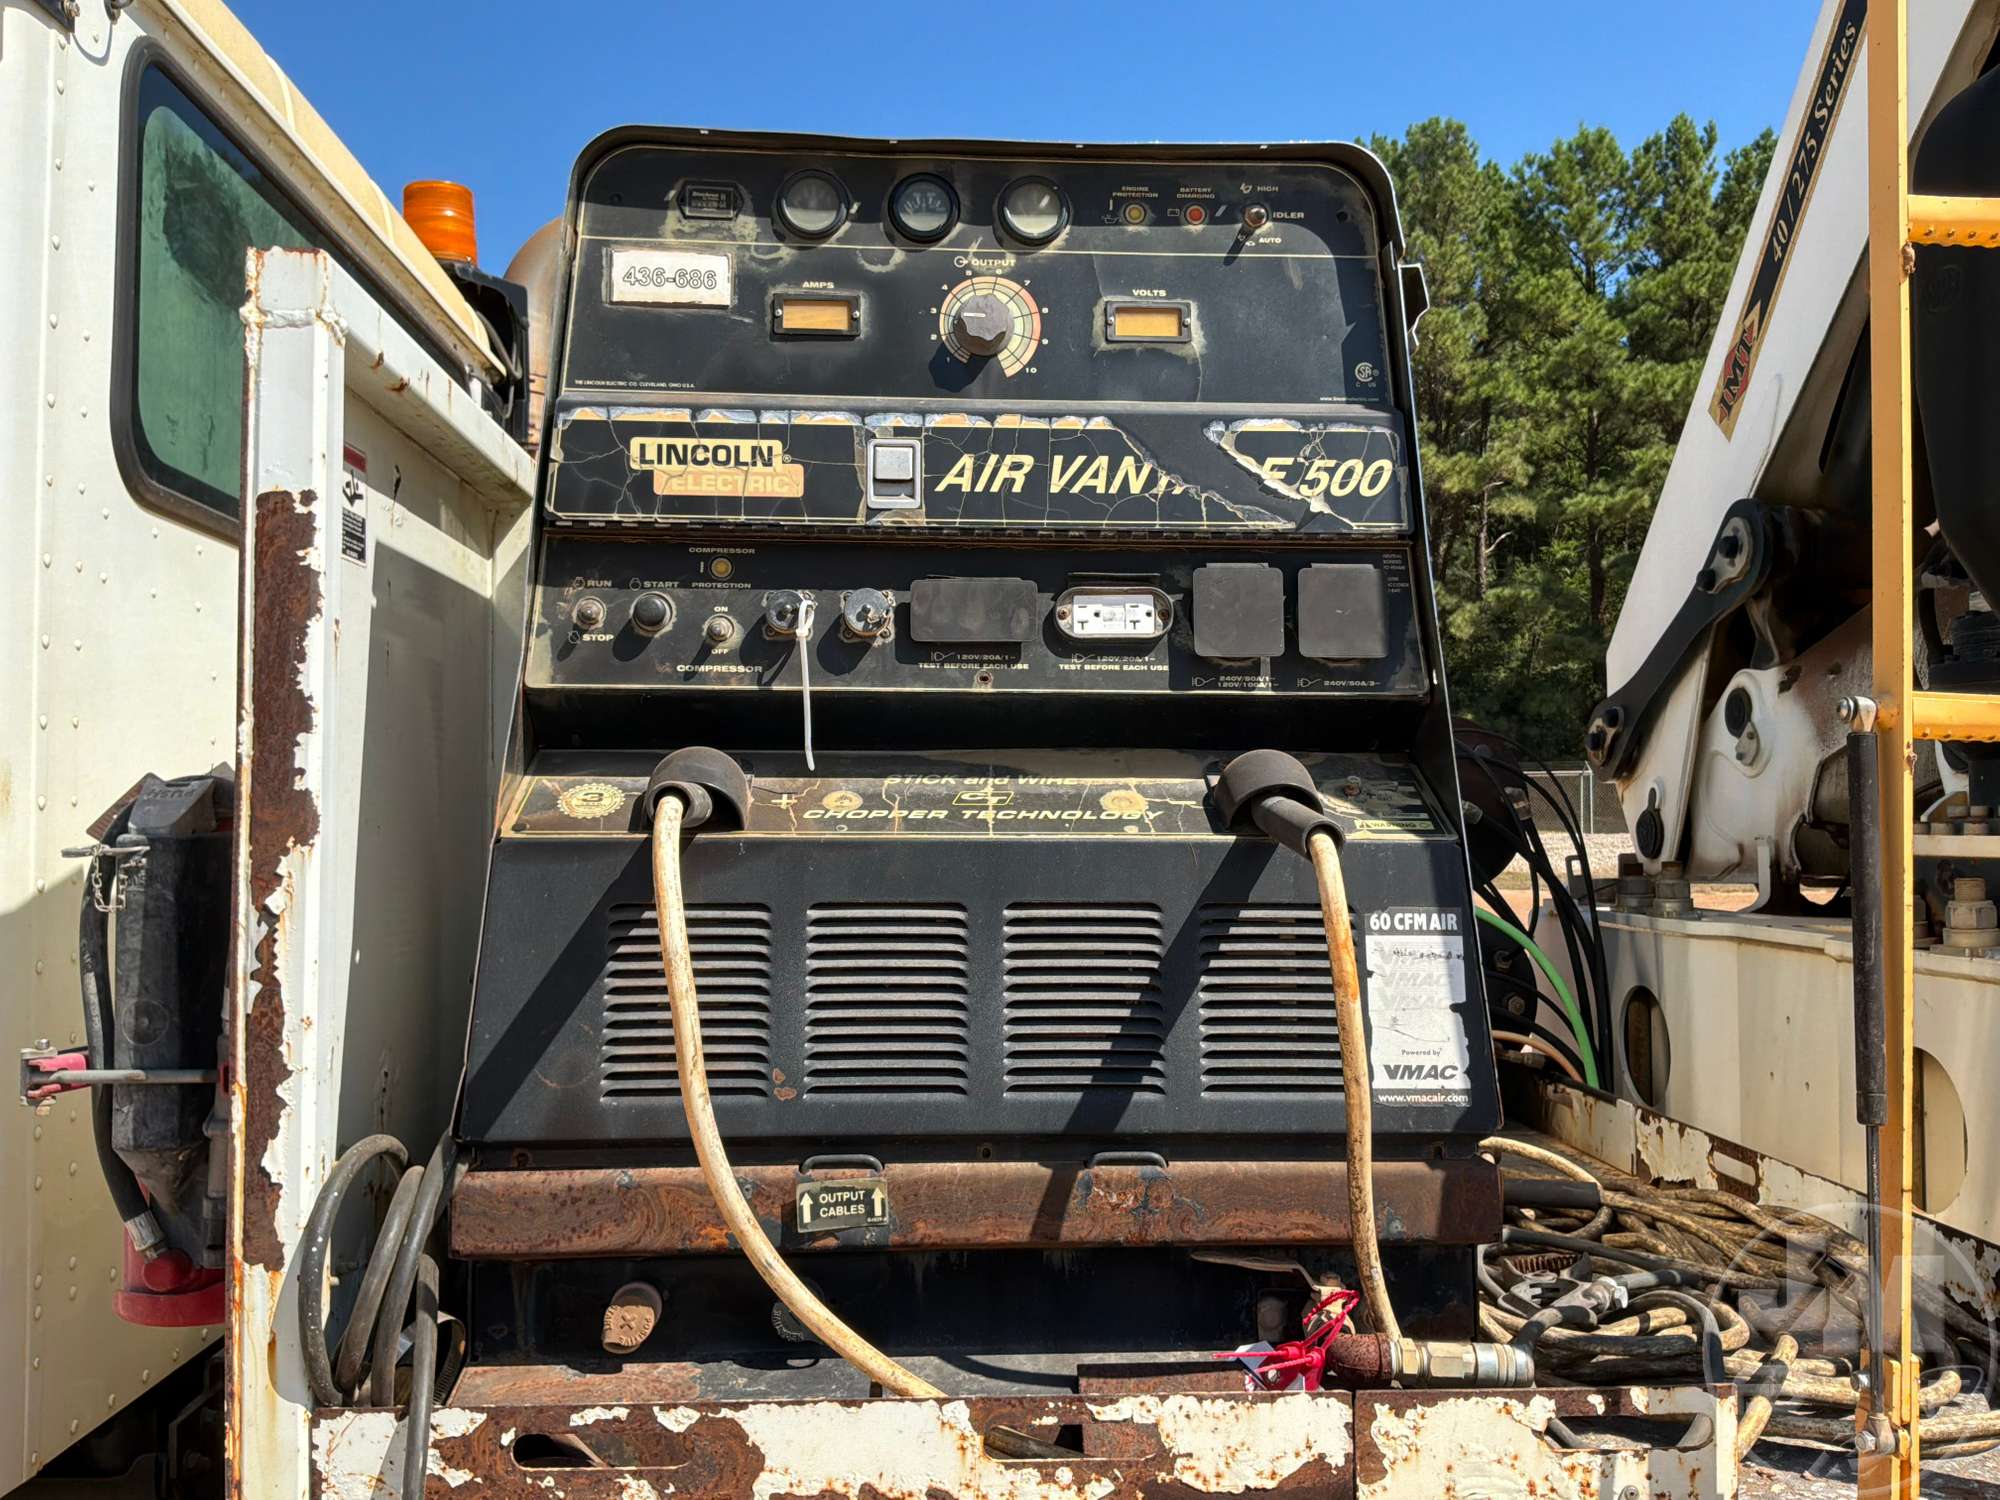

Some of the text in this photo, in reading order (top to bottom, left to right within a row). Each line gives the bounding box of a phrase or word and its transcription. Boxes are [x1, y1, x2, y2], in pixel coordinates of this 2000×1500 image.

[1790, 131, 1818, 201] 275
[1813, 20, 1857, 132] Series
[1256, 185, 1279, 193] HIGH
[1272, 211, 1305, 219] IDLER
[971, 259, 1017, 267] OUTPUT
[622, 266, 717, 290] 436-686
[801, 281, 836, 290] AMPS
[1131, 288, 1168, 299] VOLTS
[1025, 366, 1037, 374] 10
[639, 443, 773, 468] LINCOLN
[934, 453, 1035, 493] AIR
[1299, 458, 1393, 497] 500
[671, 474, 791, 493] ELECTRIC
[582, 633, 615, 642] STOP
[676, 663, 763, 674] COMPRESSOR
[1059, 663, 1082, 671] TEST
[884, 775, 957, 785] STICK
[963, 775, 1008, 785] and
[803, 809, 1164, 820] CHOPPER TECHNOLOGY
[1369, 912, 1458, 932] 60 CFM AIR
[1432, 1048, 1441, 1058] by
[1383, 1064, 1459, 1080] VMAC
[1378, 1090, 1469, 1103] www.vmacair.com
[819, 1190, 866, 1204] OUTPUT
[819, 1204, 865, 1218] CABLES
